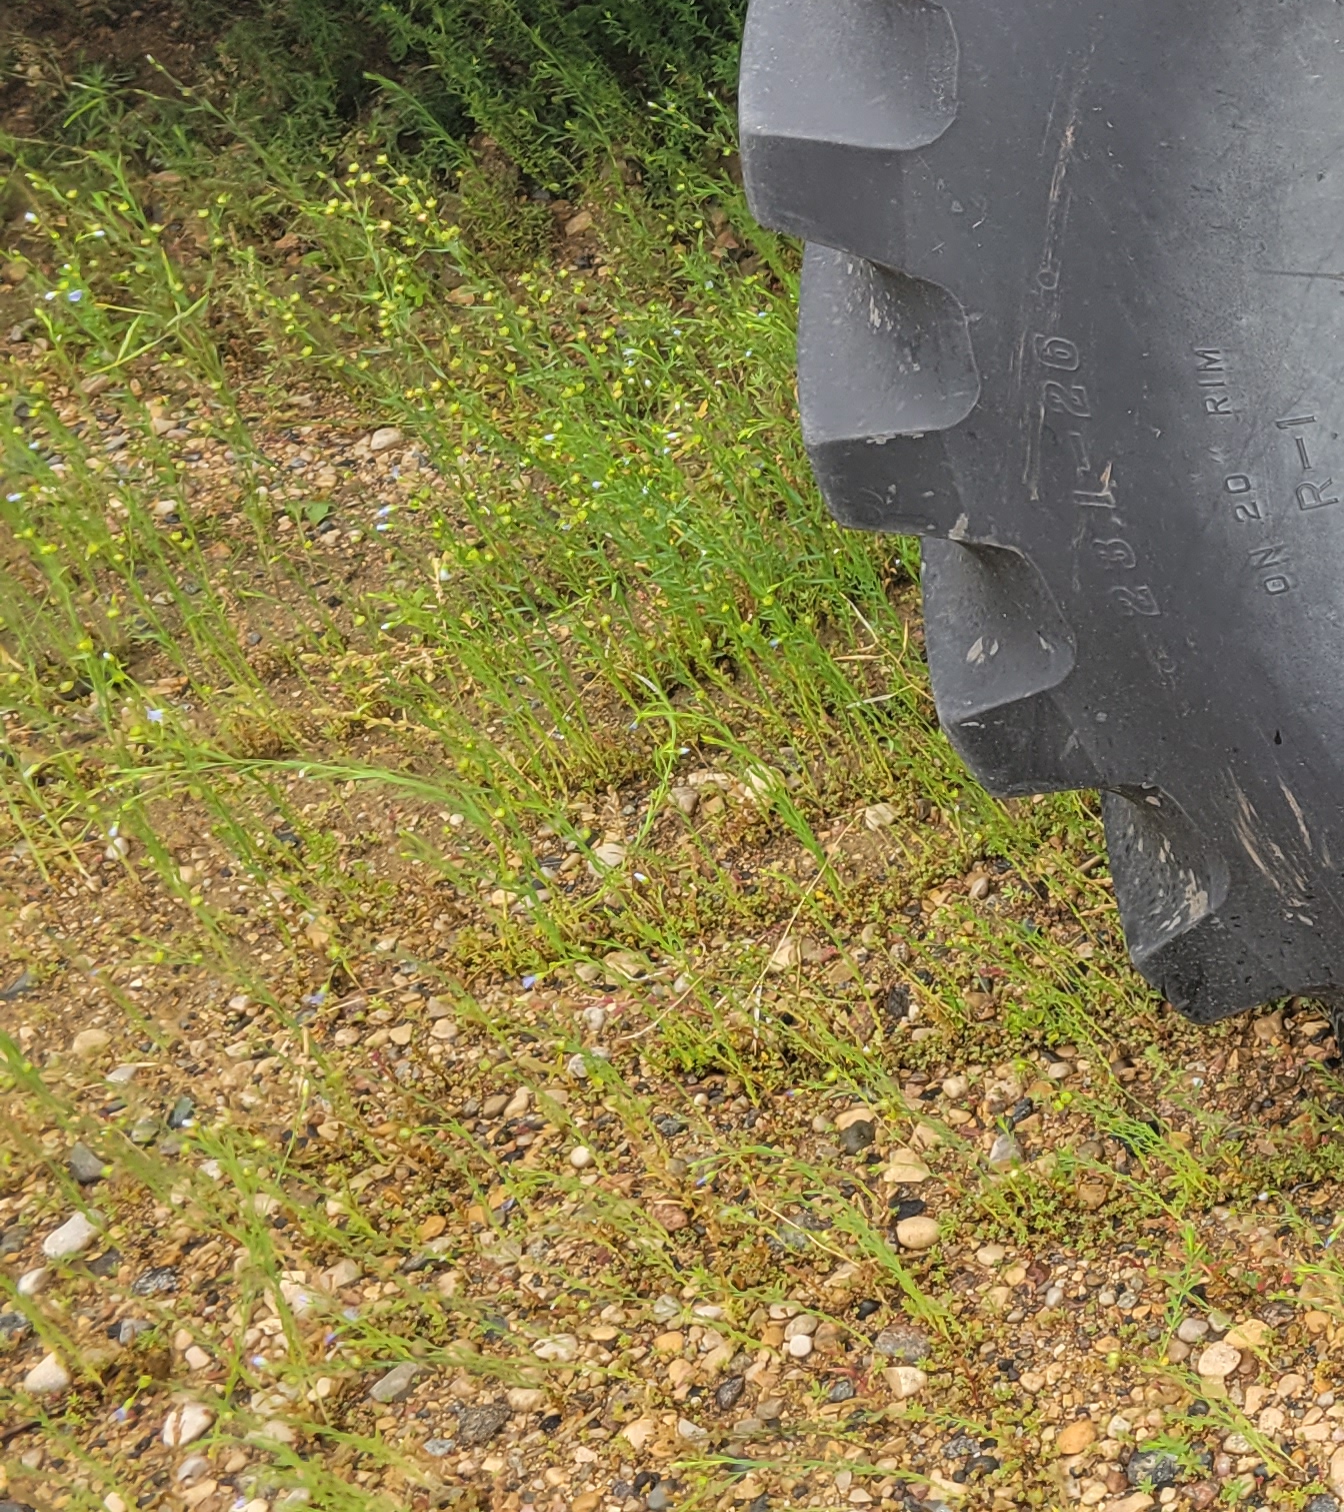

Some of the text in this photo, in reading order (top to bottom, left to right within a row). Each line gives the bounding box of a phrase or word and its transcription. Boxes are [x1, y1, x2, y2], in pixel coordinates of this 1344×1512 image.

[1195, 346, 1233, 417] RIM
[1274, 414, 1341, 512] R-1
[1249, 543, 1291, 596] ON
